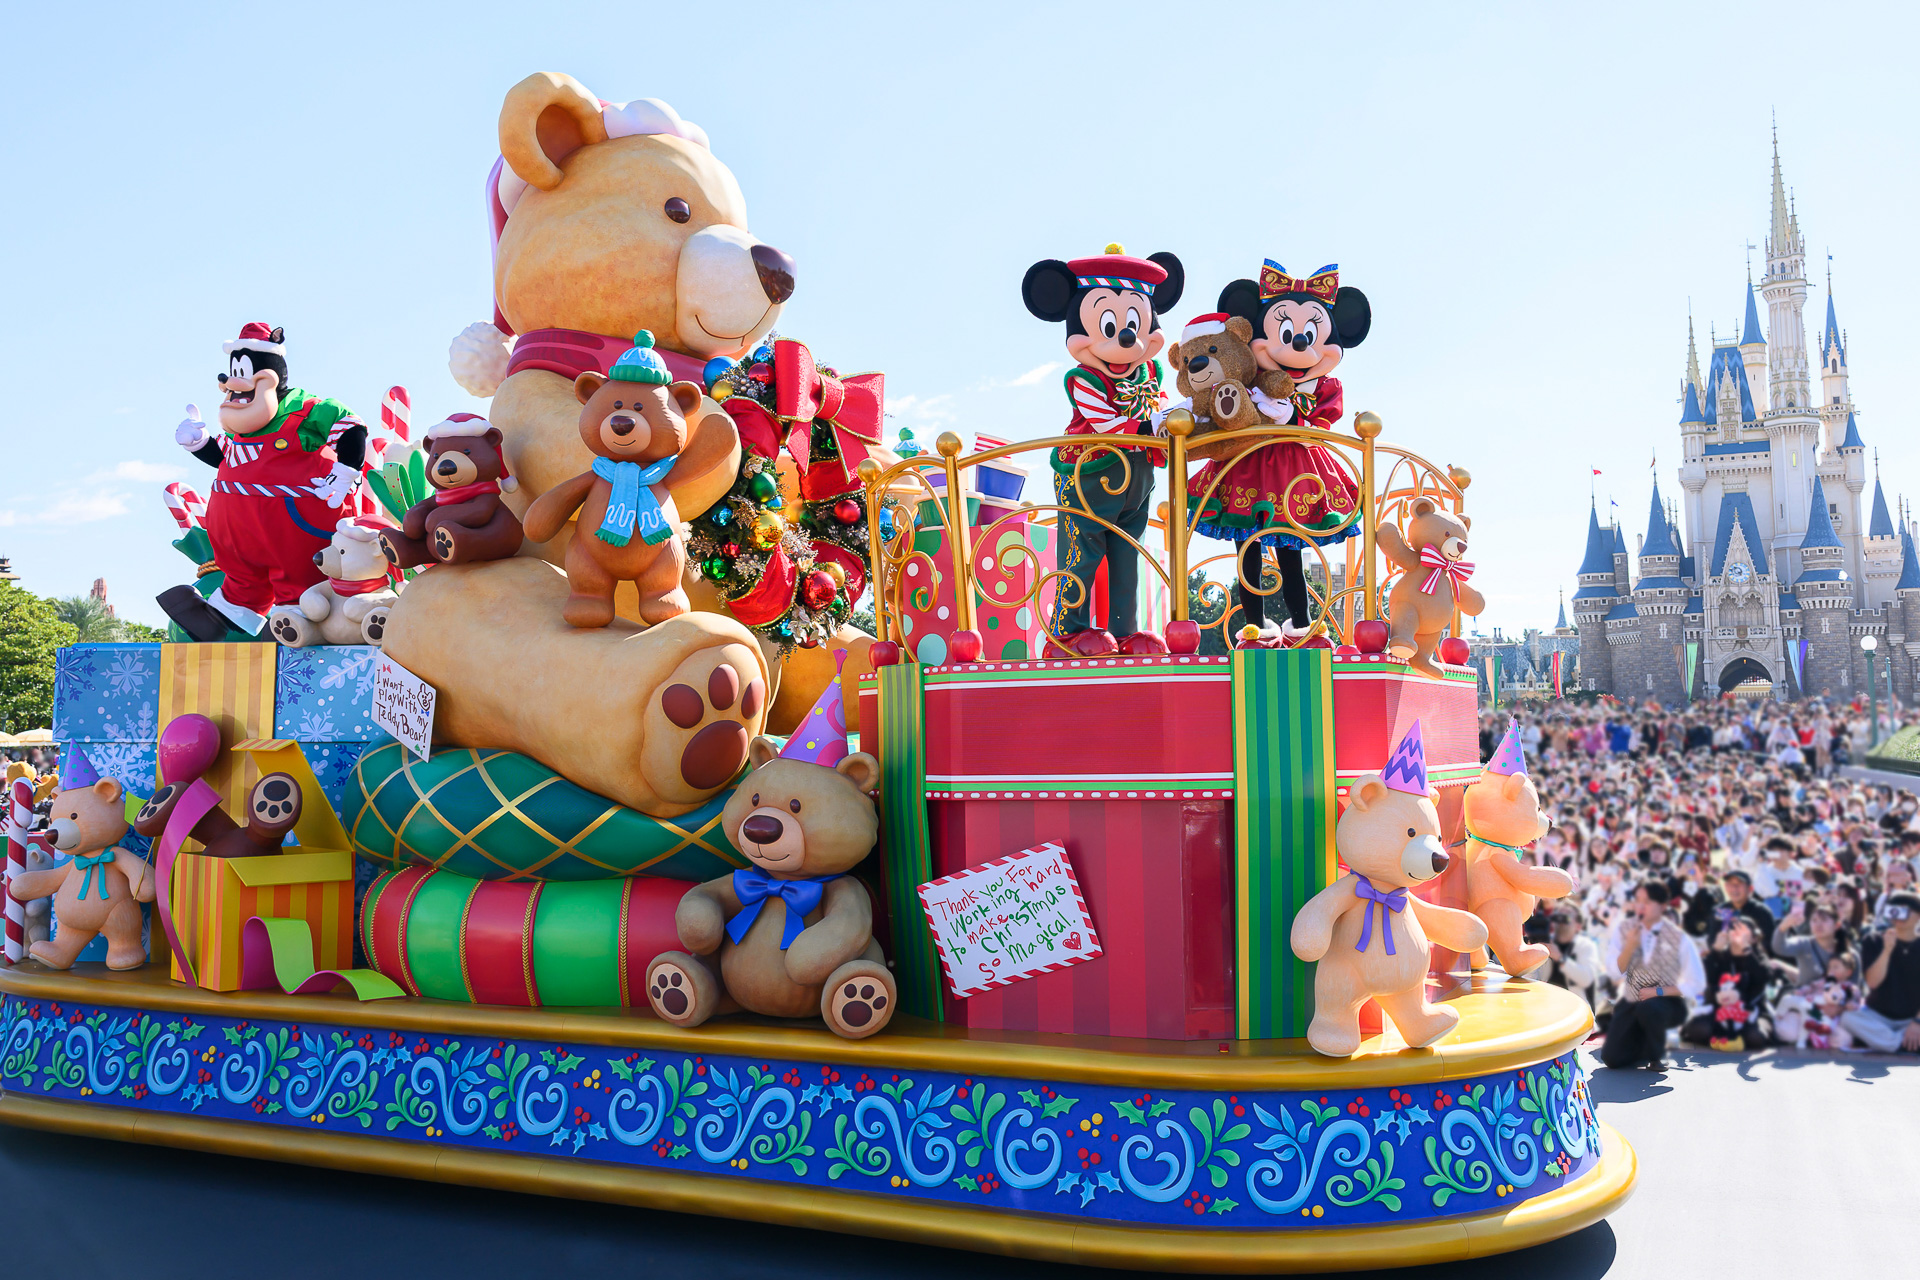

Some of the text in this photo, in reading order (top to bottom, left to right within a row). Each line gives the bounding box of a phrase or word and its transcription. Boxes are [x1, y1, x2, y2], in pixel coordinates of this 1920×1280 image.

[376, 669, 380, 684] I
[407, 687, 416, 700] to
[375, 701, 427, 749] Teddy Bear!
[416, 715, 428, 734] my
[1023, 858, 1062, 892] hard
[932, 888, 979, 921] Thank
[947, 914, 1009, 966] to make
[978, 957, 1001, 981] So
